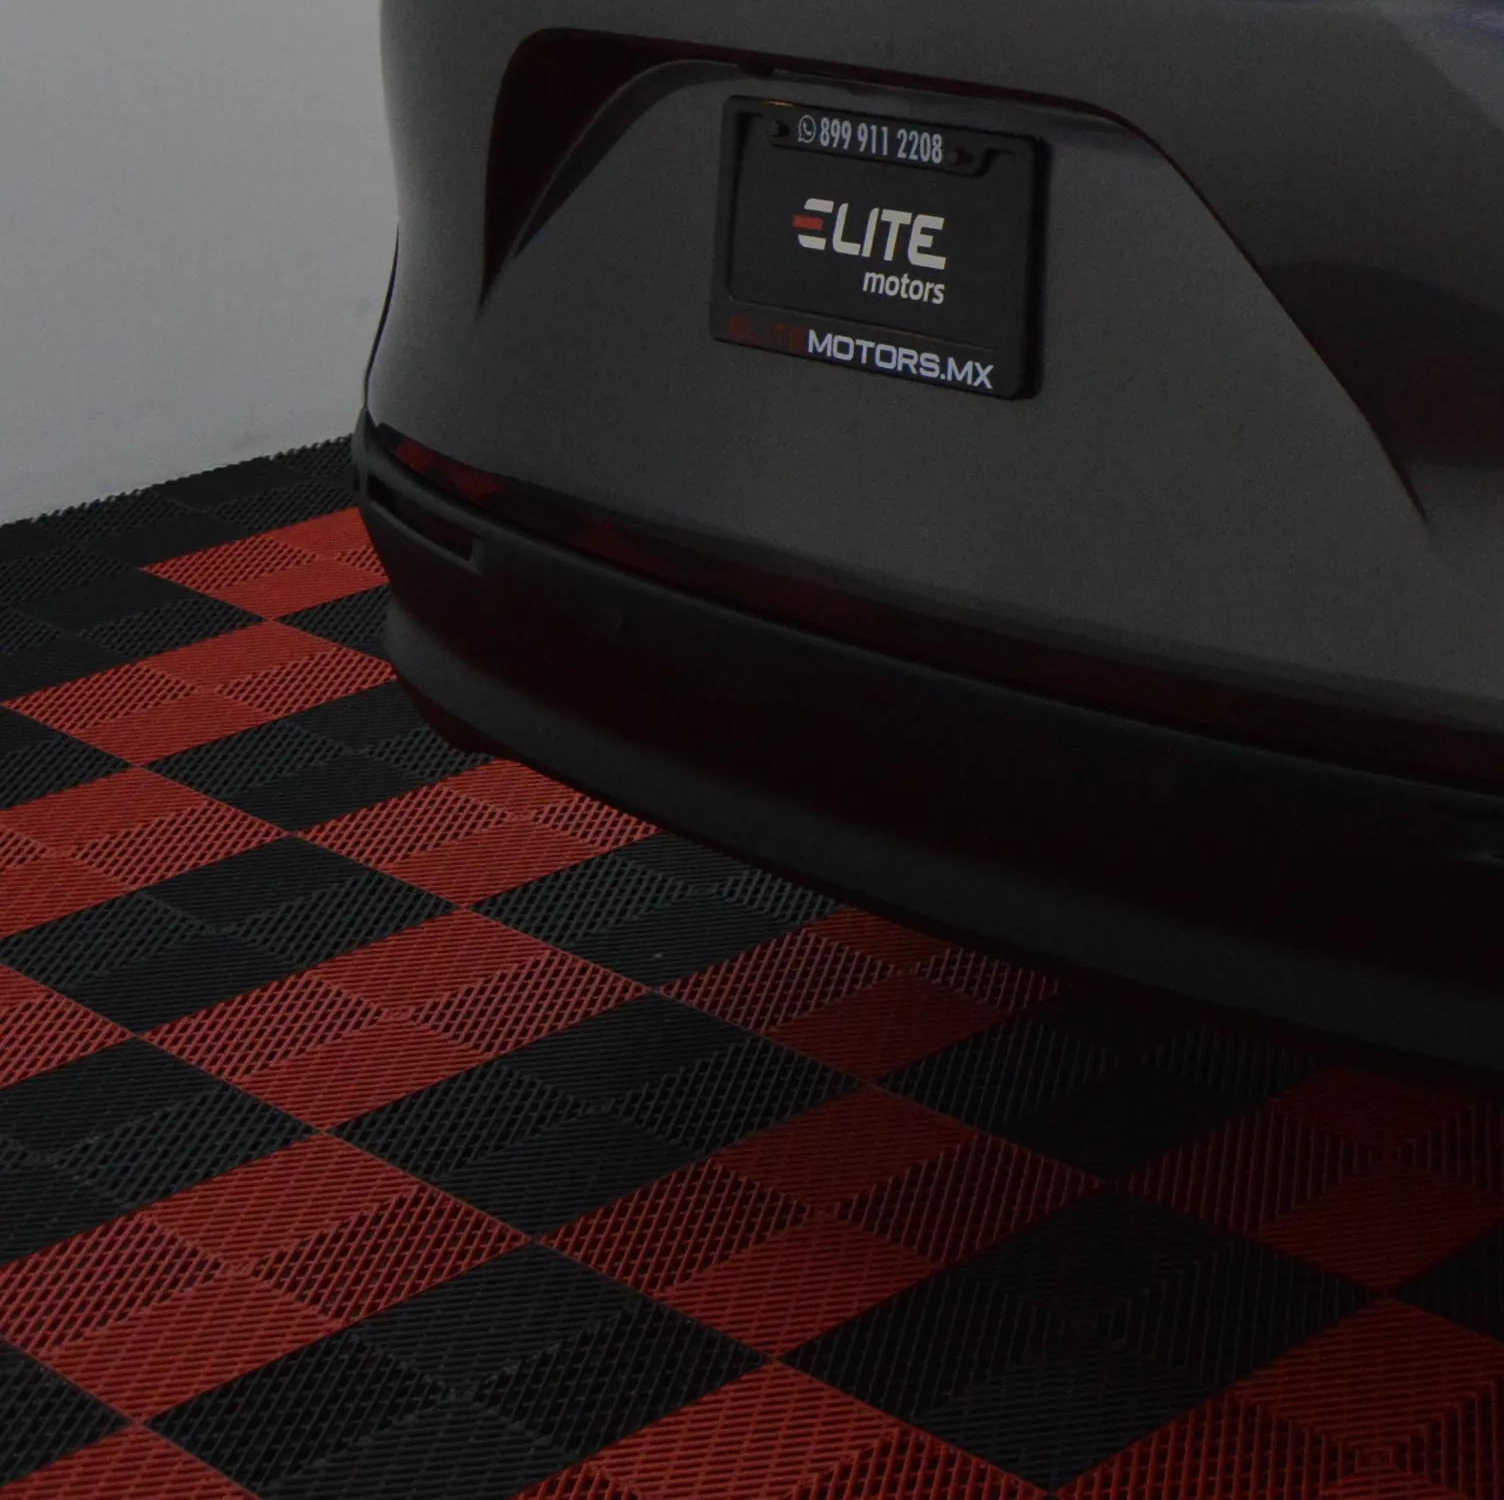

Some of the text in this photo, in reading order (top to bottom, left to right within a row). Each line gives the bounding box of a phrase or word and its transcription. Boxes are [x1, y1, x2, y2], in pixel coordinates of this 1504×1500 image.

[819, 118, 943, 164] 899 911 2208
[792, 198, 947, 270] ELITE
[862, 270, 946, 305] motors
